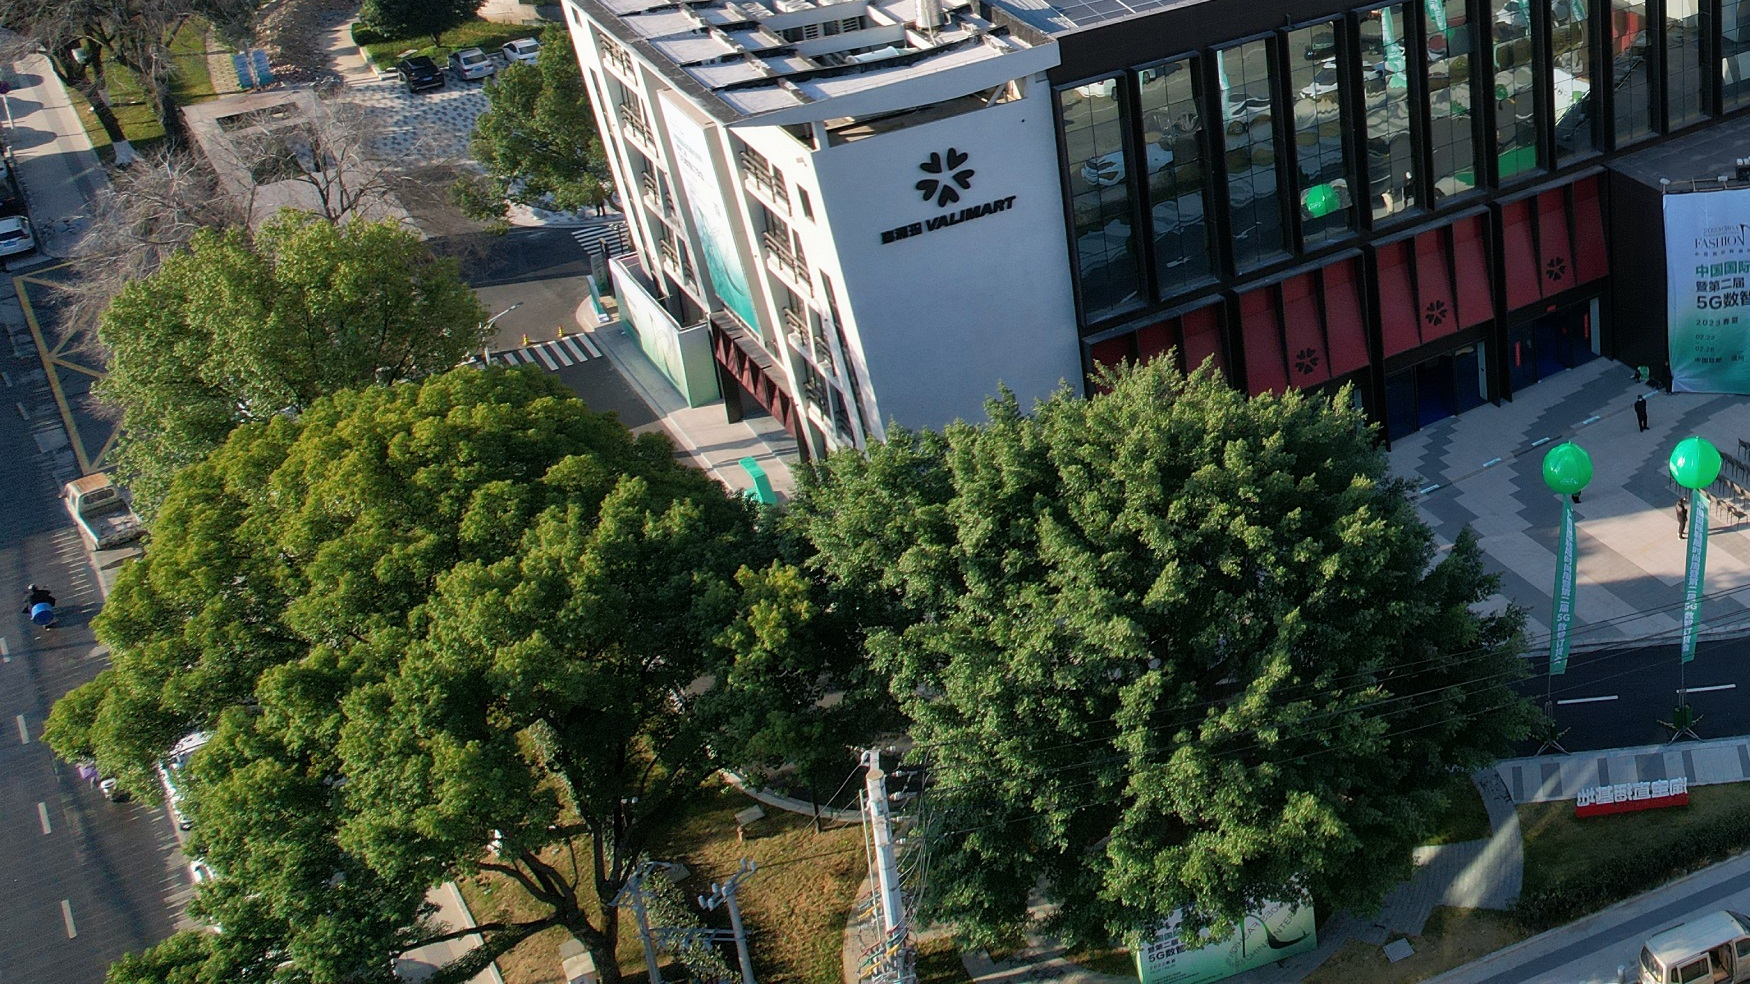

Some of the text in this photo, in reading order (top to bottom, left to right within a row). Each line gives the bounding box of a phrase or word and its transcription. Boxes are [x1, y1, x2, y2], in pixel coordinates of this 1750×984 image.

[925, 195, 1016, 232] VALIMART
[1696, 277, 1745, 293] 暨第二届
